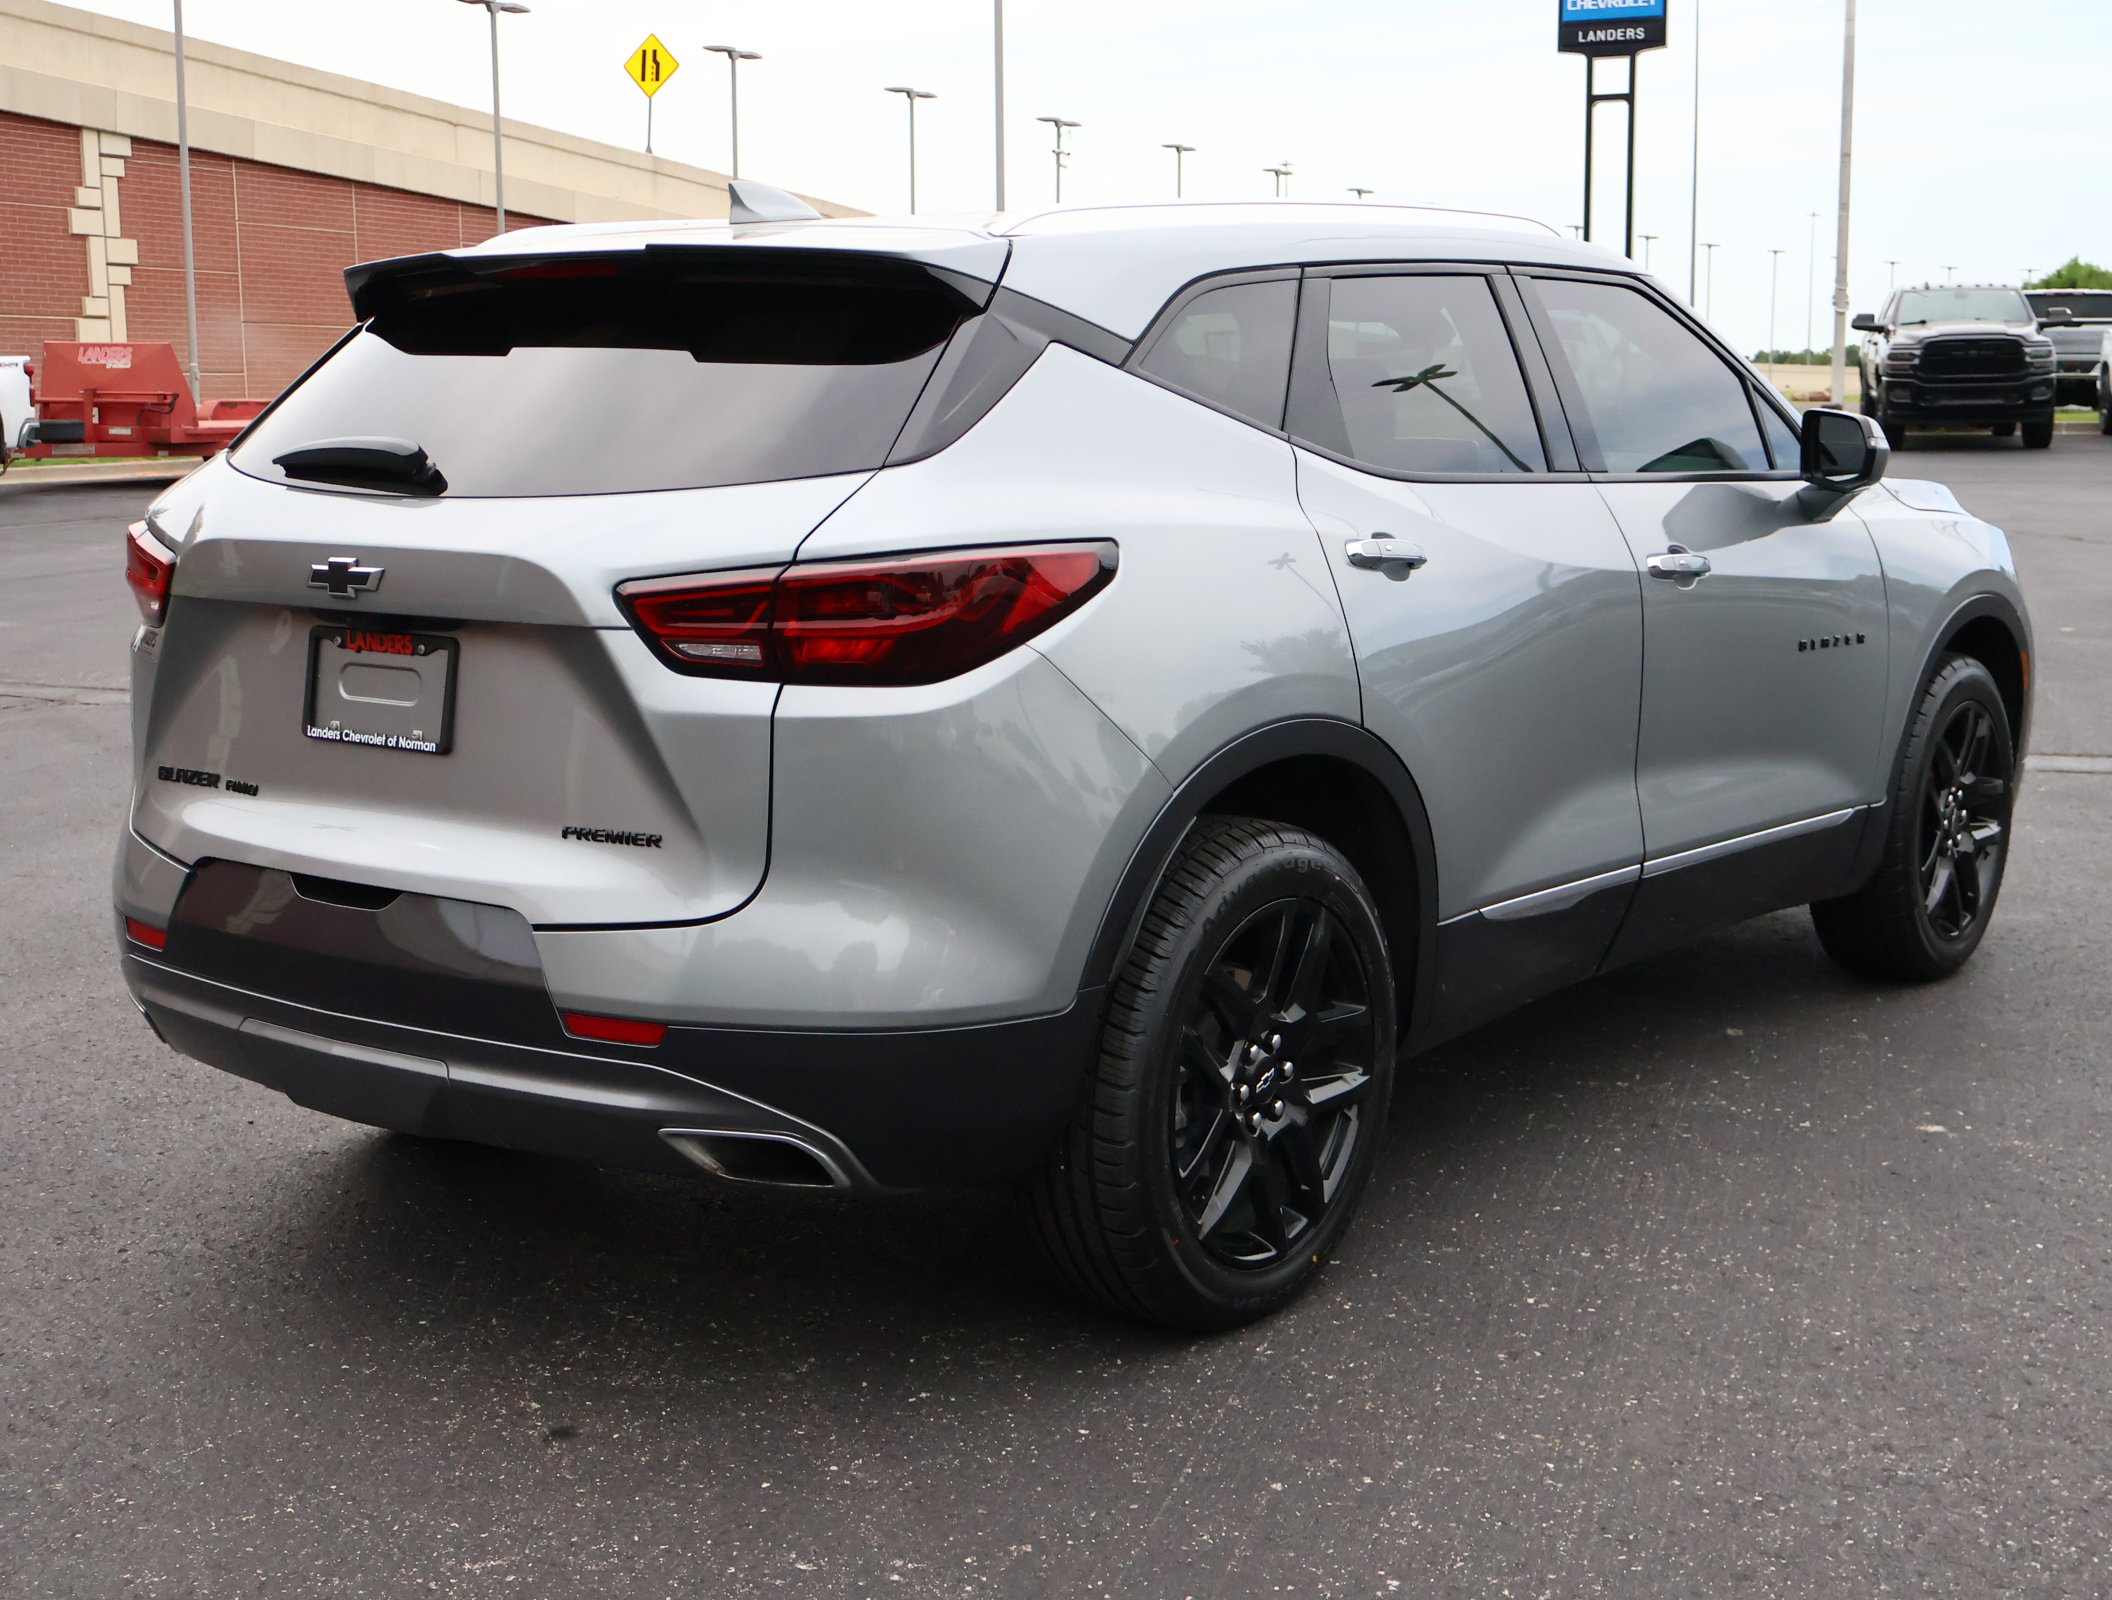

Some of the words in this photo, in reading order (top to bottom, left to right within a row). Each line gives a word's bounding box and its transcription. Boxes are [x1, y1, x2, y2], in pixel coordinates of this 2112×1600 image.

[1578, 27, 1645, 42] LANDERS
[346, 629, 414, 656] LANDERS
[307, 724, 341, 740] Landers
[342, 729, 386, 746] Chevrolet
[387, 735, 398, 747] of
[399, 736, 436, 752] Norman
[158, 765, 220, 789] BLAZER
[561, 826, 663, 849] PREMIER
